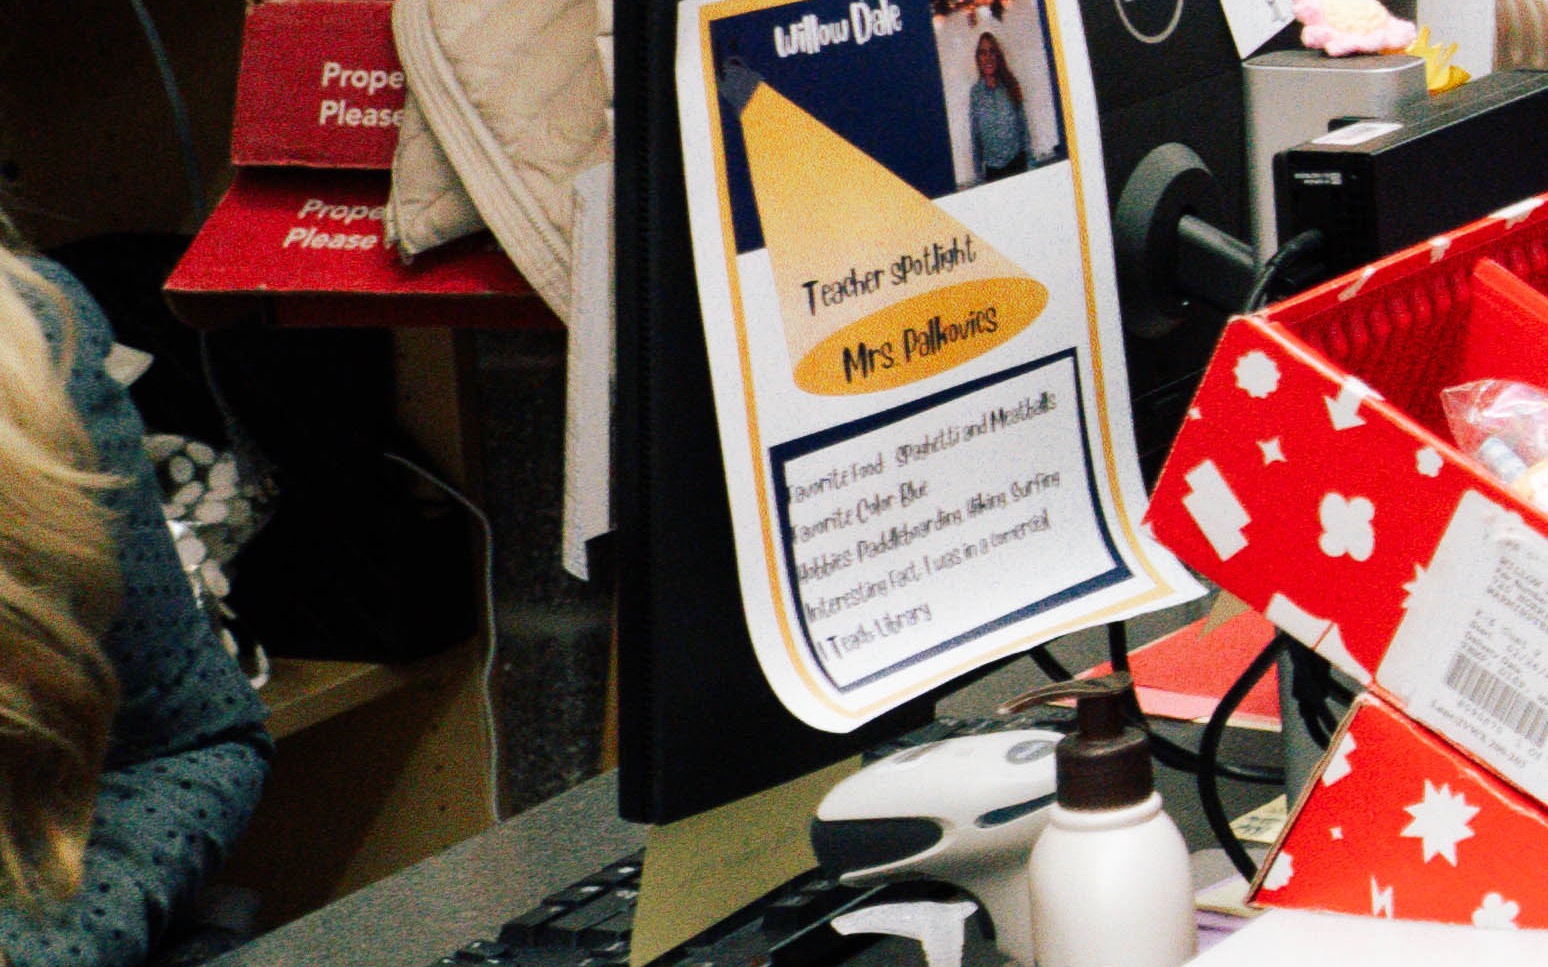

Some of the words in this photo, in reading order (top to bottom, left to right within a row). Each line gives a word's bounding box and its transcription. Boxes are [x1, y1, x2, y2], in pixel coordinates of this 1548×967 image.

[773, 12, 850, 59] Willow
[318, 99, 404, 128] Please
[281, 226, 379, 251] Please
[801, 266, 884, 316] Teacher
[842, 340, 896, 383] Mrs
[902, 305, 1000, 365] Palkovics
